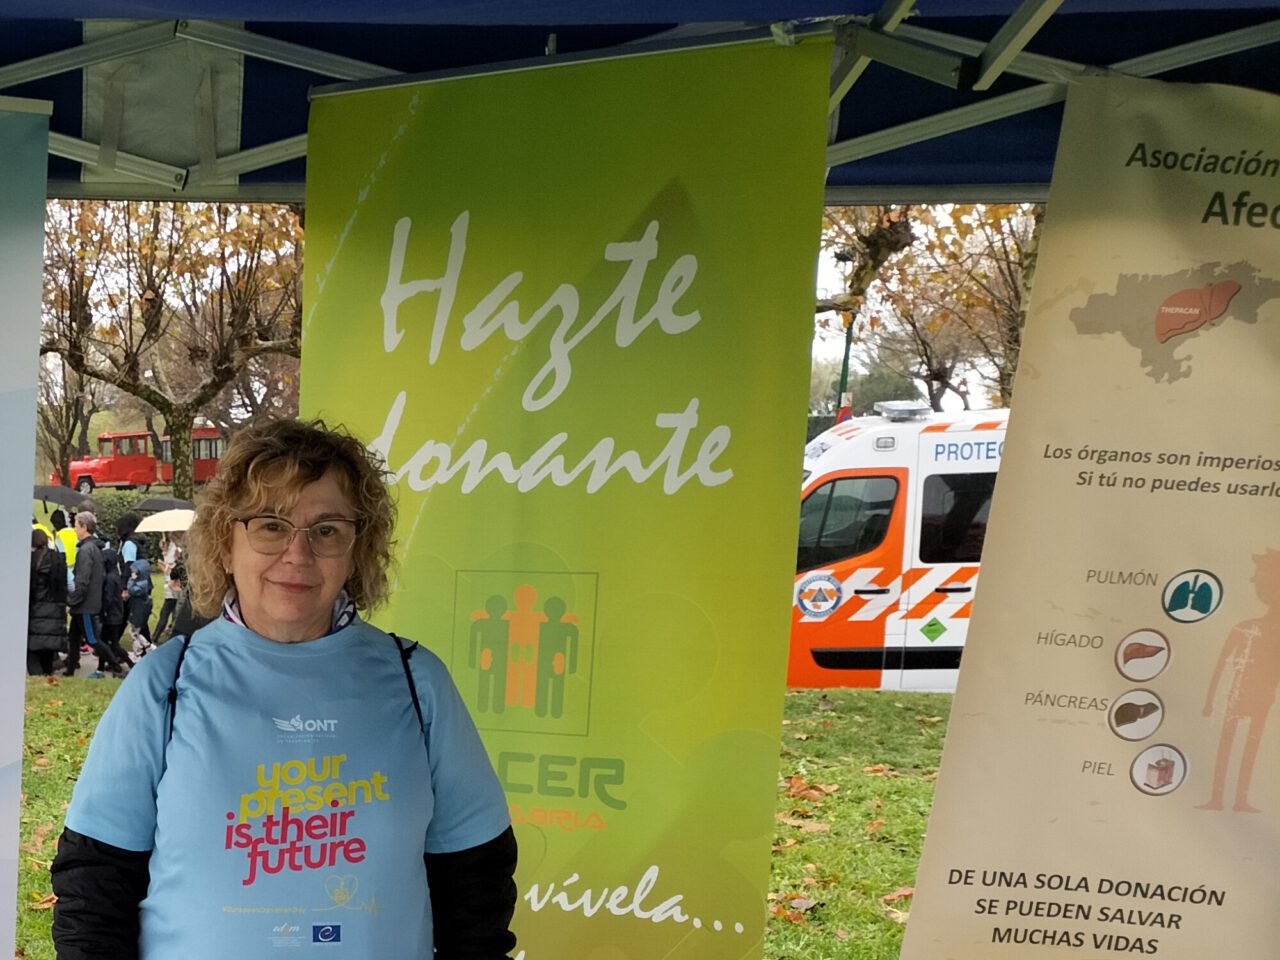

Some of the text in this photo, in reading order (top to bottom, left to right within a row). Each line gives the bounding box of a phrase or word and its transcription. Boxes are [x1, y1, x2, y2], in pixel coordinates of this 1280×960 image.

[1125, 142, 1280, 178] Asociación
[380, 210, 701, 411] Hazte
[1161, 306, 1200, 315] THEPACAN
[367, 390, 734, 495] donante
[1044, 444, 1072, 460] Los
[1077, 445, 1151, 464] órganos
[1157, 453, 1191, 466] son
[1076, 471, 1093, 486] Si
[1098, 472, 1117, 487] tú
[1122, 477, 1146, 488] no
[1150, 477, 1221, 493] puedes
[1086, 569, 1158, 586] PULMÓN
[1036, 629, 1103, 649] HÍGADO
[1024, 690, 1108, 712] PÁNCREAS
[305, 720, 338, 731] ONT
[256, 754, 347, 793] your
[497, 751, 627, 811] CER
[1081, 760, 1115, 776] PIEL
[240, 771, 390, 824] present
[225, 800, 355, 849] is their
[242, 837, 366, 886] future
[524, 865, 744, 933] vívela...
[948, 869, 1226, 907] DE UNA SOLA DONACIÓN
[974, 898, 1182, 930] SE PUEDEN SALVAR
[991, 927, 1159, 955] MUCHAS VIDAS
